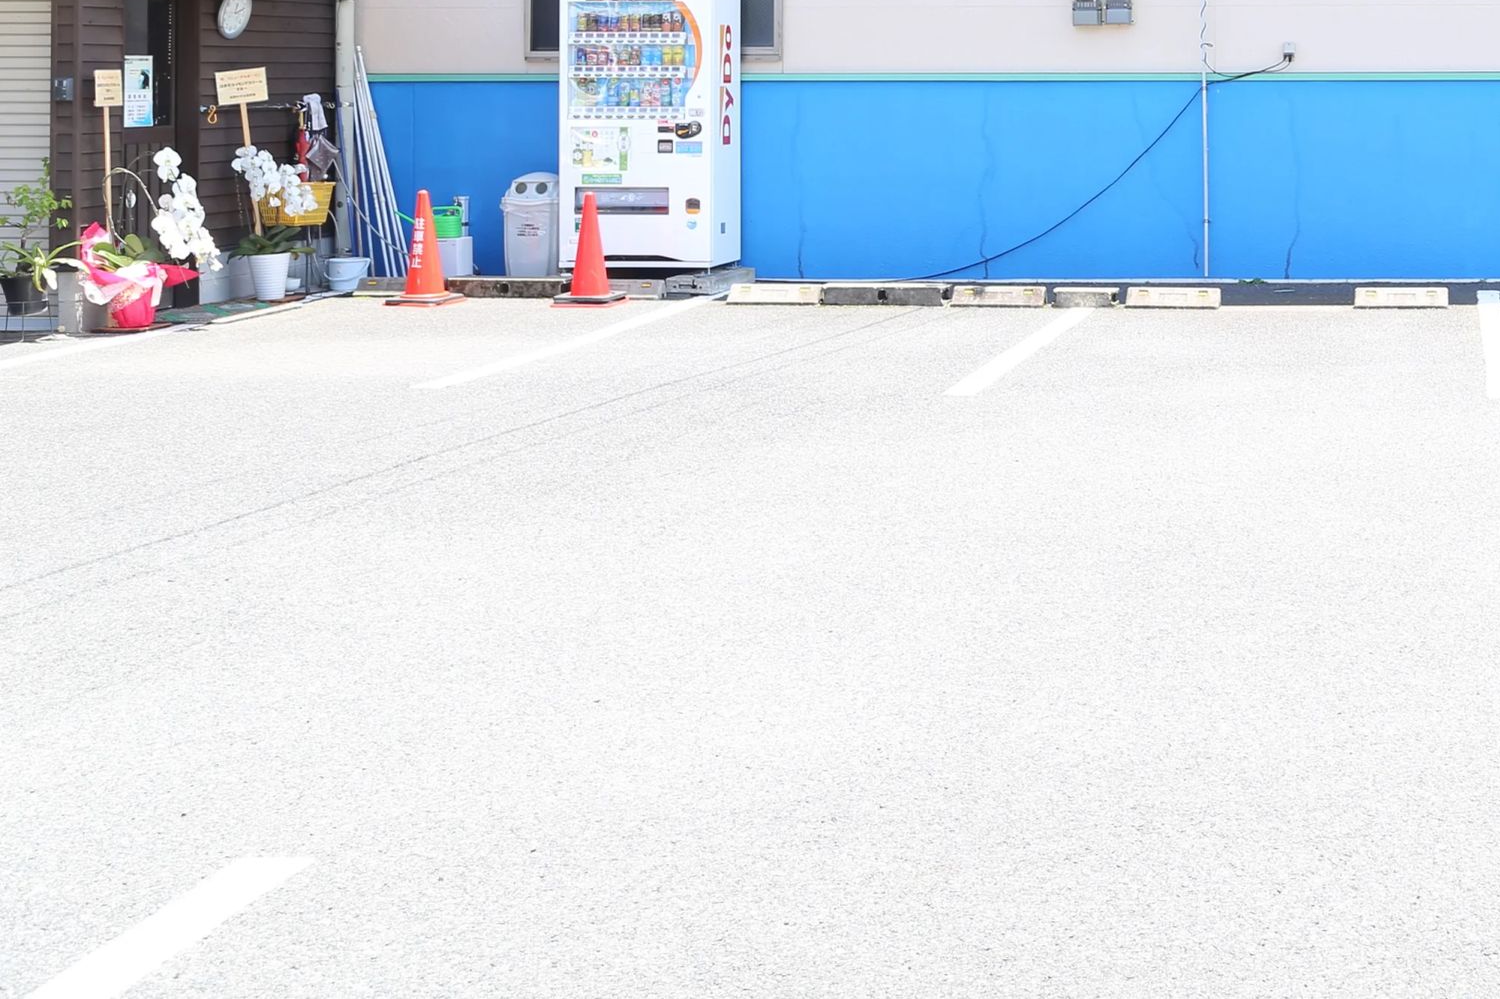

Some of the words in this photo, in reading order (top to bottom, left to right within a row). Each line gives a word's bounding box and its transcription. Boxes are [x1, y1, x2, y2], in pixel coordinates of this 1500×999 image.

[722, 25, 734, 145] DYDO
[411, 217, 425, 269] 駐車禁止
